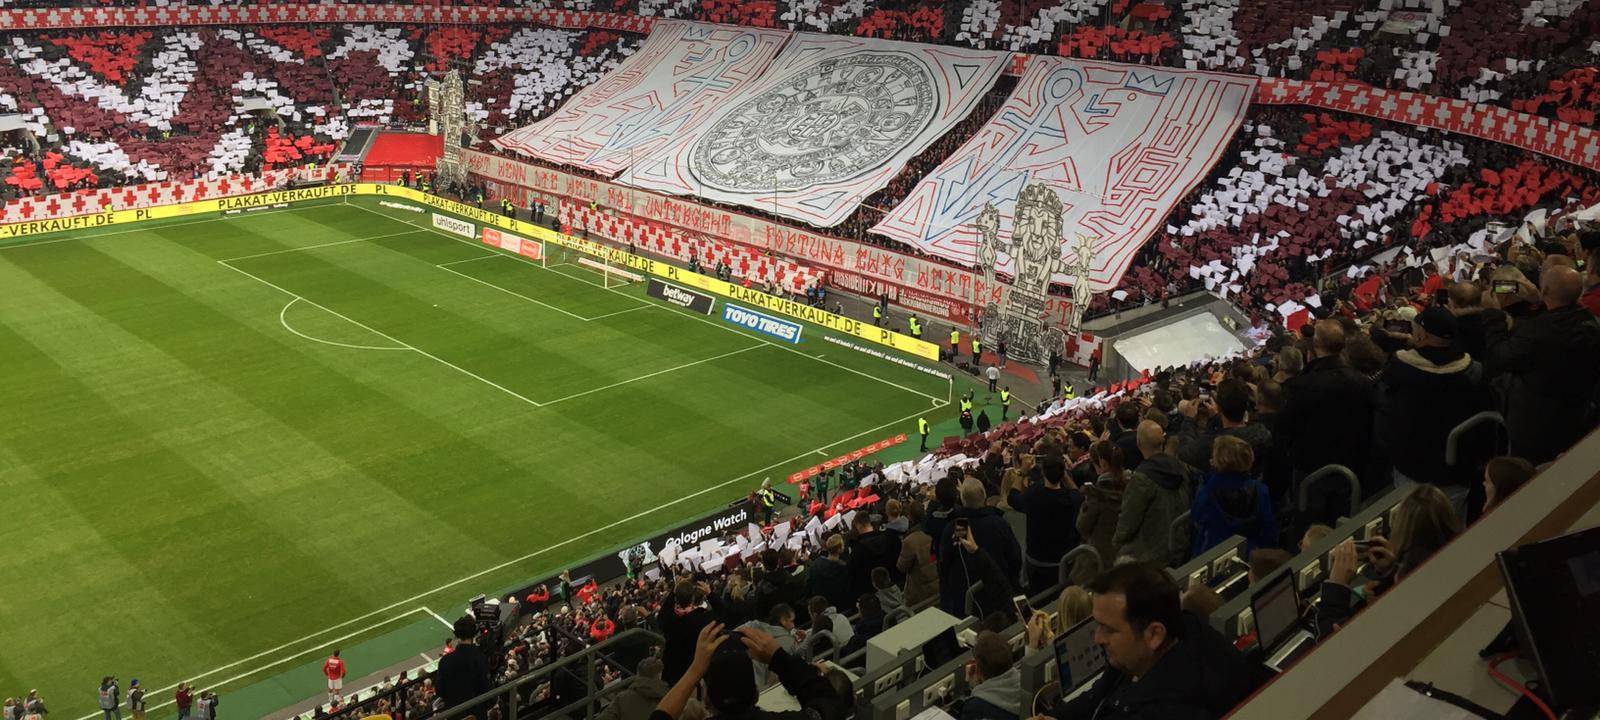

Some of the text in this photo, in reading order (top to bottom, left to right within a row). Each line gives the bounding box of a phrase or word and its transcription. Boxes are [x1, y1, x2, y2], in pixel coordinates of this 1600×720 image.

[218, 184, 388, 210] PLAKAT-VERKAUFT.DE PL
[136, 208, 152, 220] PL
[423, 193, 500, 226] PLAKAT-VERKAUFT.DE
[510, 218, 519, 231] PL
[436, 215, 470, 234] uhlsport
[556, 232, 654, 273] PLAKATVERKAUFT.DE
[668, 266, 680, 280] PL
[765, 225, 846, 265] FORTUNA
[663, 284, 695, 306] betway
[725, 307, 797, 340] TOYO TIRES
[729, 284, 861, 336] PLAKAT-VERKAUFT.DE
[881, 330, 896, 346] PL
[713, 509, 747, 531] Watch
